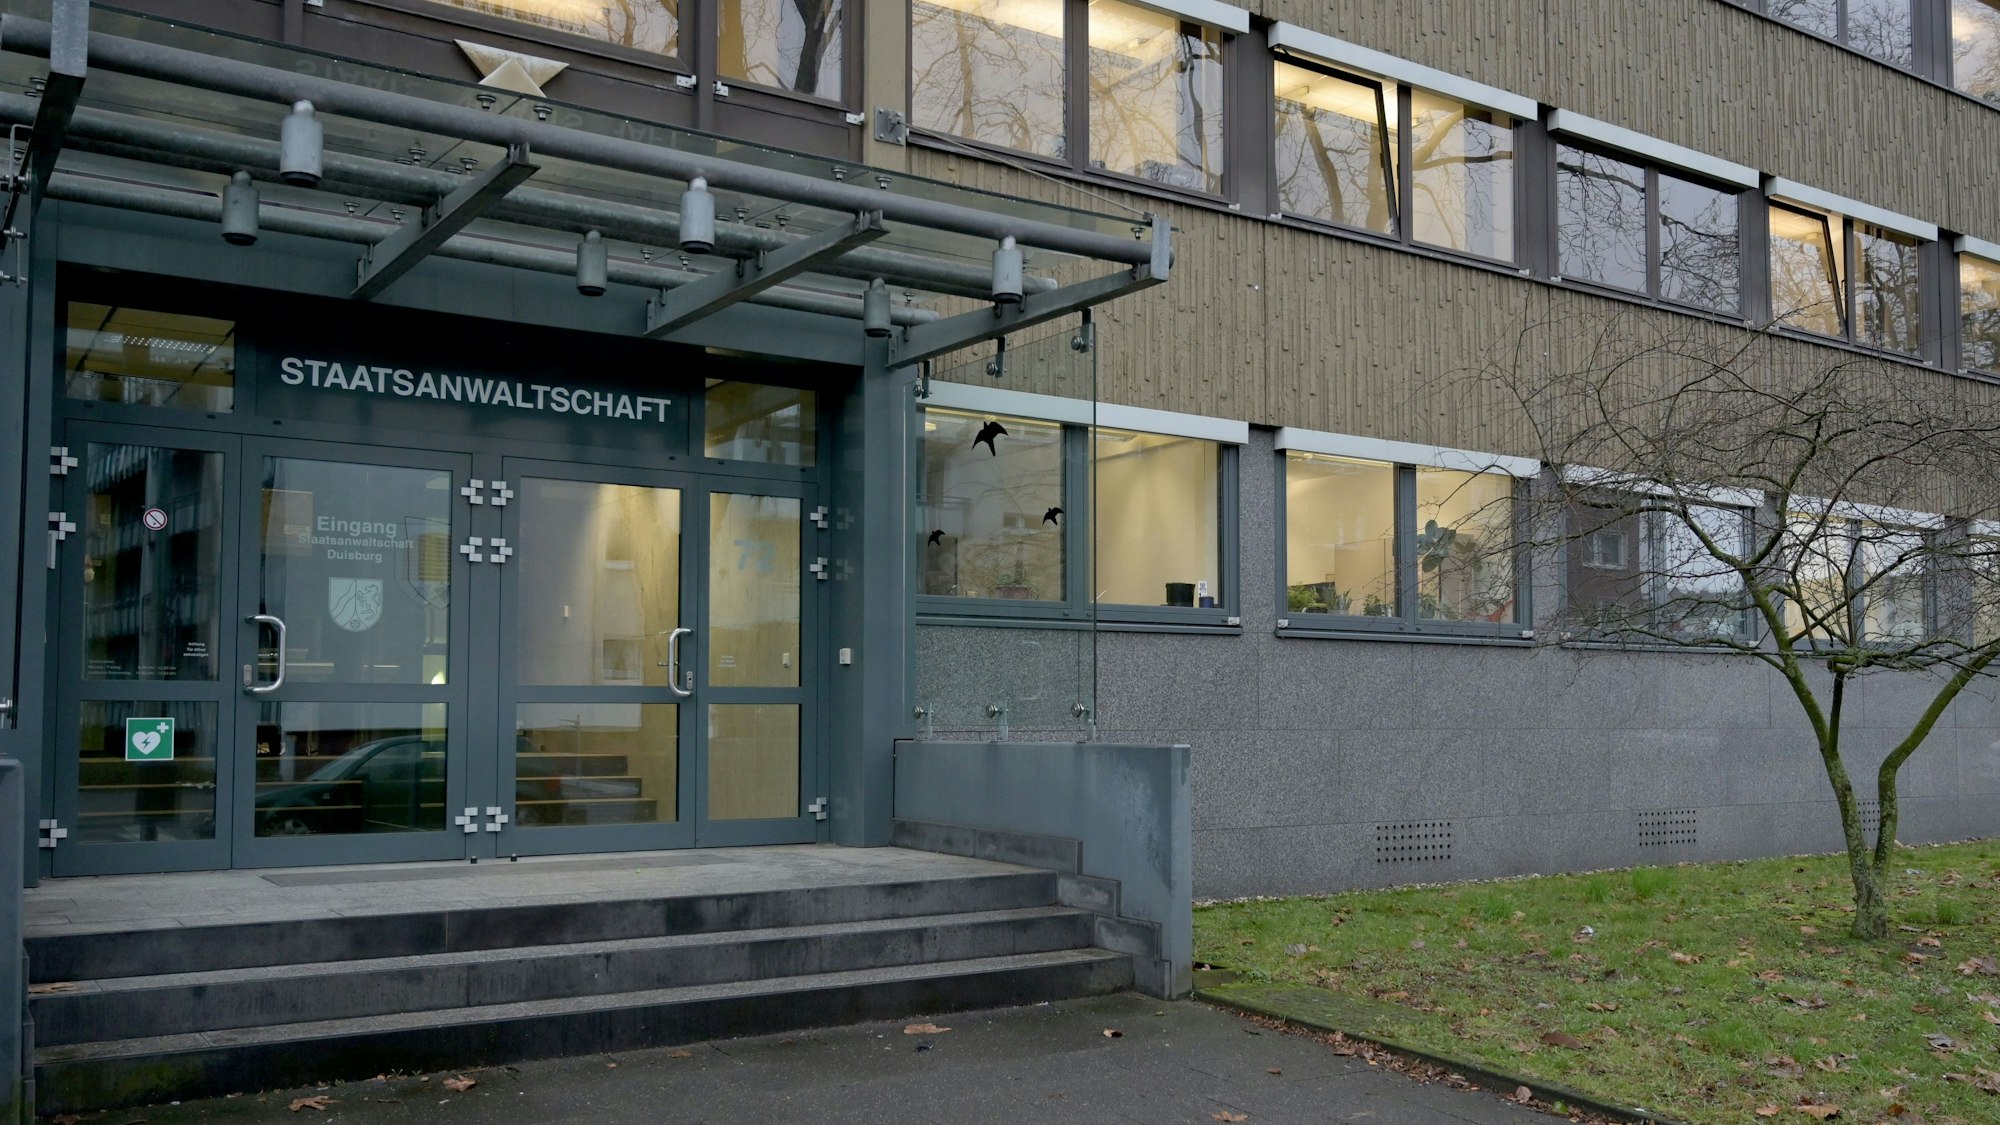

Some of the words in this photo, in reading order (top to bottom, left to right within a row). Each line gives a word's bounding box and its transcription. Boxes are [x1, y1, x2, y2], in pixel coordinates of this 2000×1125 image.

[281, 357, 671, 422] STAATSANWALTSCHAFT
[316, 515, 398, 538] Eingang
[297, 533, 414, 550] Staatsanwaltschaft
[327, 549, 383, 564] Duisburg
[733, 538, 776, 573] 72
